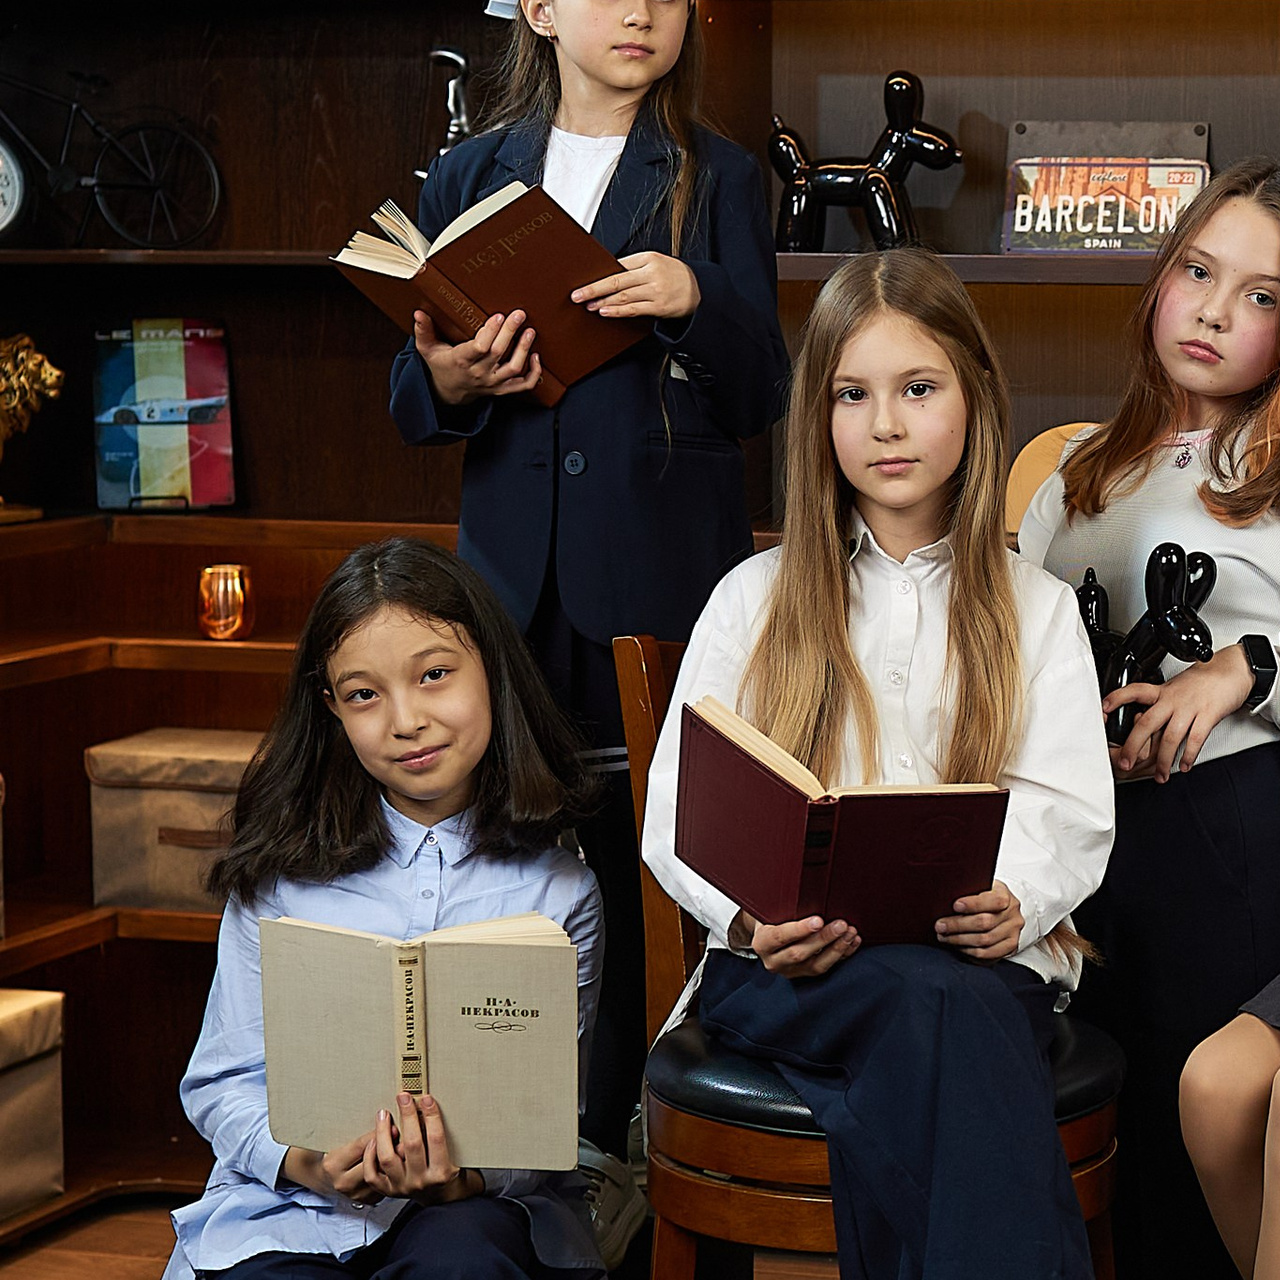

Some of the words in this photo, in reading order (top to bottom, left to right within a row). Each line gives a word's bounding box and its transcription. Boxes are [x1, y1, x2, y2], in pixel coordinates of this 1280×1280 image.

[1091, 171, 1127, 185] explore
[1014, 194, 1179, 234] BARCELON
[1084, 238, 1122, 249] SPAIN
[461, 1007, 540, 1018] НЕКРАСОВ
